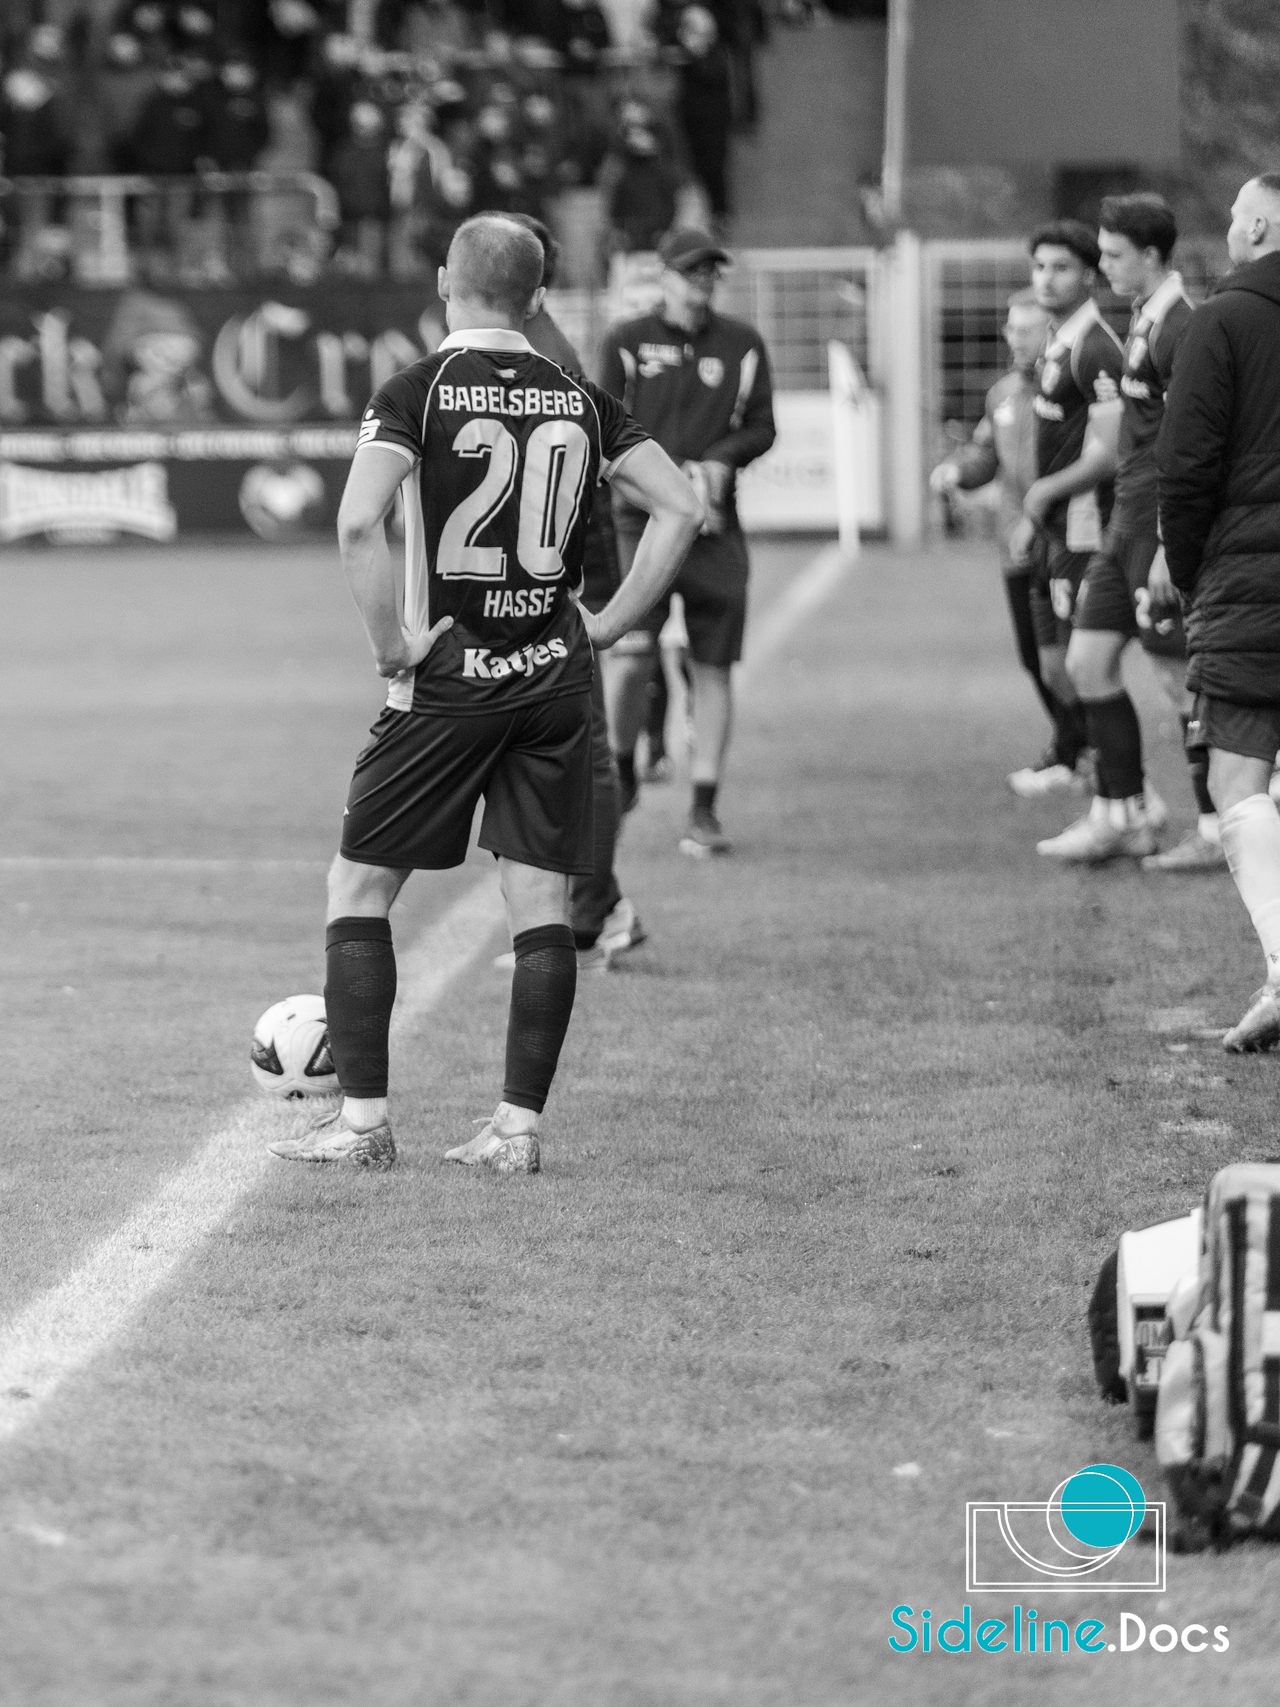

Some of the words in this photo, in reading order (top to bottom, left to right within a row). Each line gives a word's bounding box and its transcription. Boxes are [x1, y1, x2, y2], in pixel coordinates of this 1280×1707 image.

[438, 384, 584, 416] BABELSBERG
[436, 418, 590, 581] 20
[483, 586, 557, 618] HASSE
[462, 637, 568, 680] Katjes
